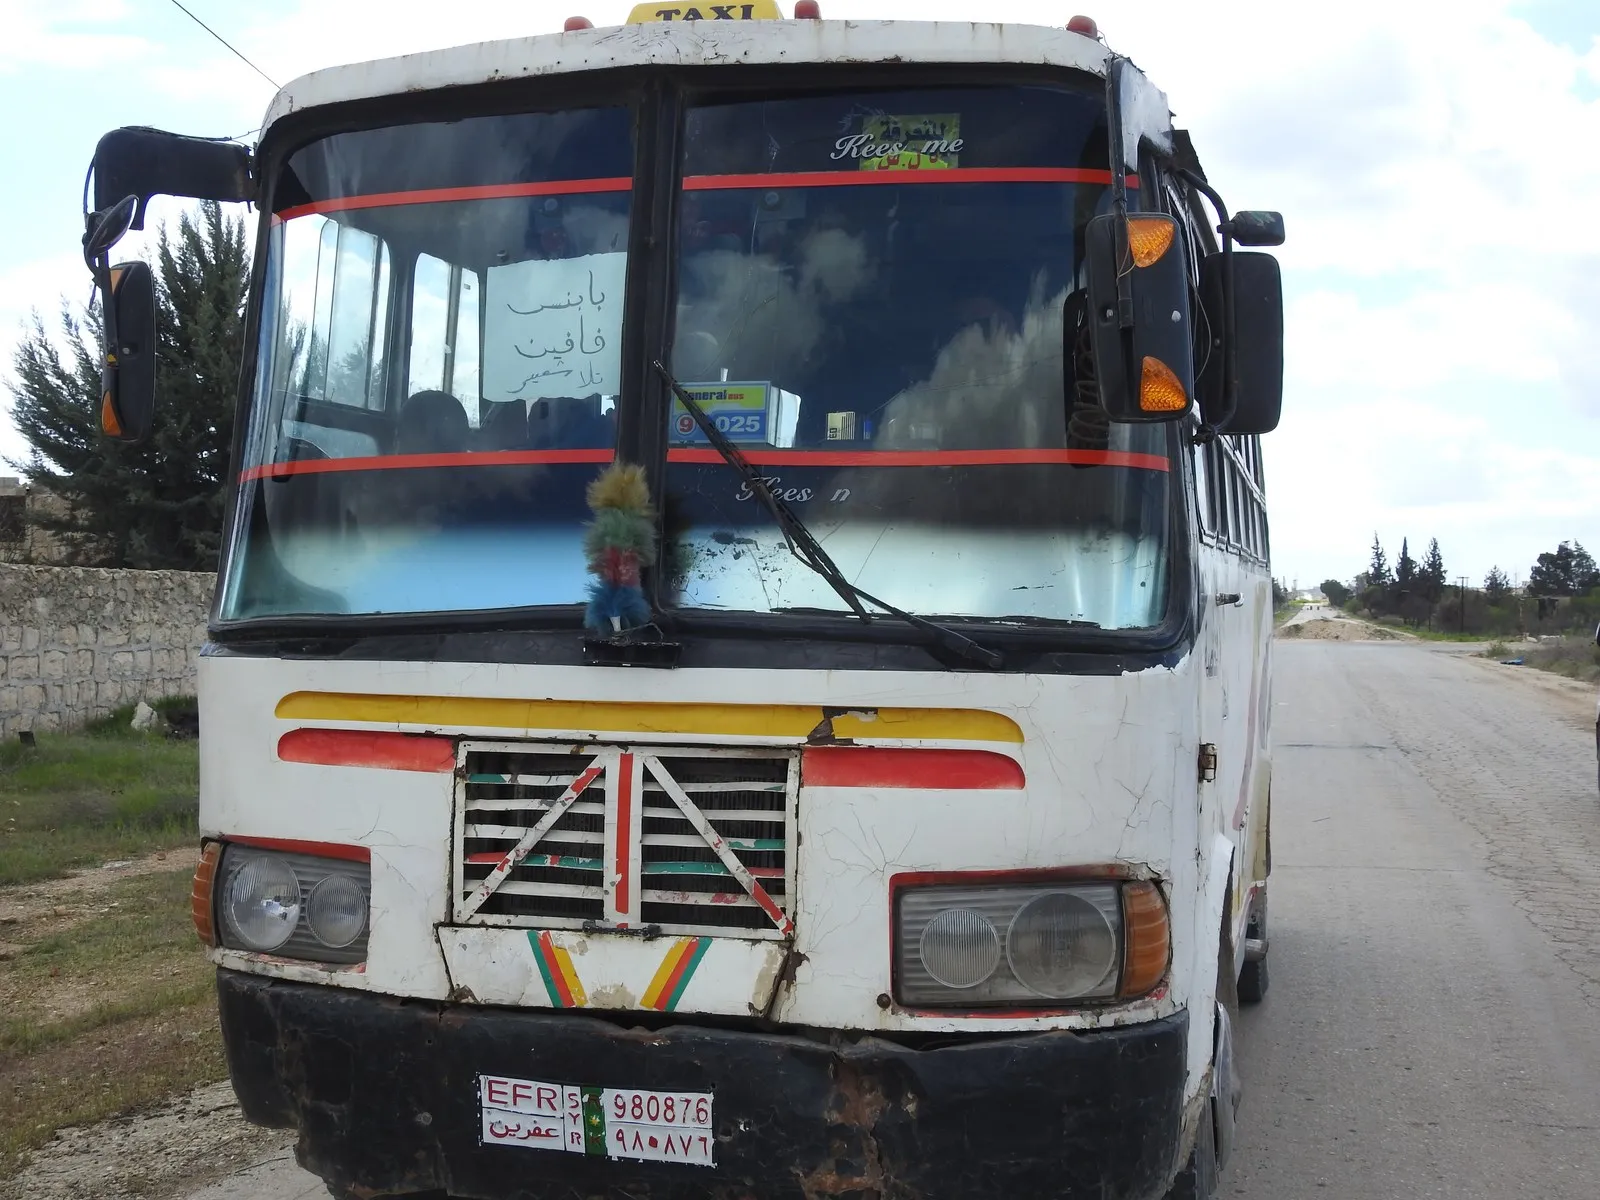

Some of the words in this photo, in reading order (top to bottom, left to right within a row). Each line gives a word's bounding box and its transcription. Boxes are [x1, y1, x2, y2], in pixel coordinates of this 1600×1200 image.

[655, 4, 755, 21] TAXI
[830, 133, 907, 160] Kees
[920, 138, 963, 153] me
[514, 315, 605, 360] فافين
[679, 418, 695, 433] 9
[715, 415, 760, 432] 025
[488, 1080, 557, 1111] EFR
[614, 1093, 708, 1125] 980876
[489, 1121, 559, 1140] عفرين
[615, 1129, 708, 1157] ٩٨٠٨٧٦
